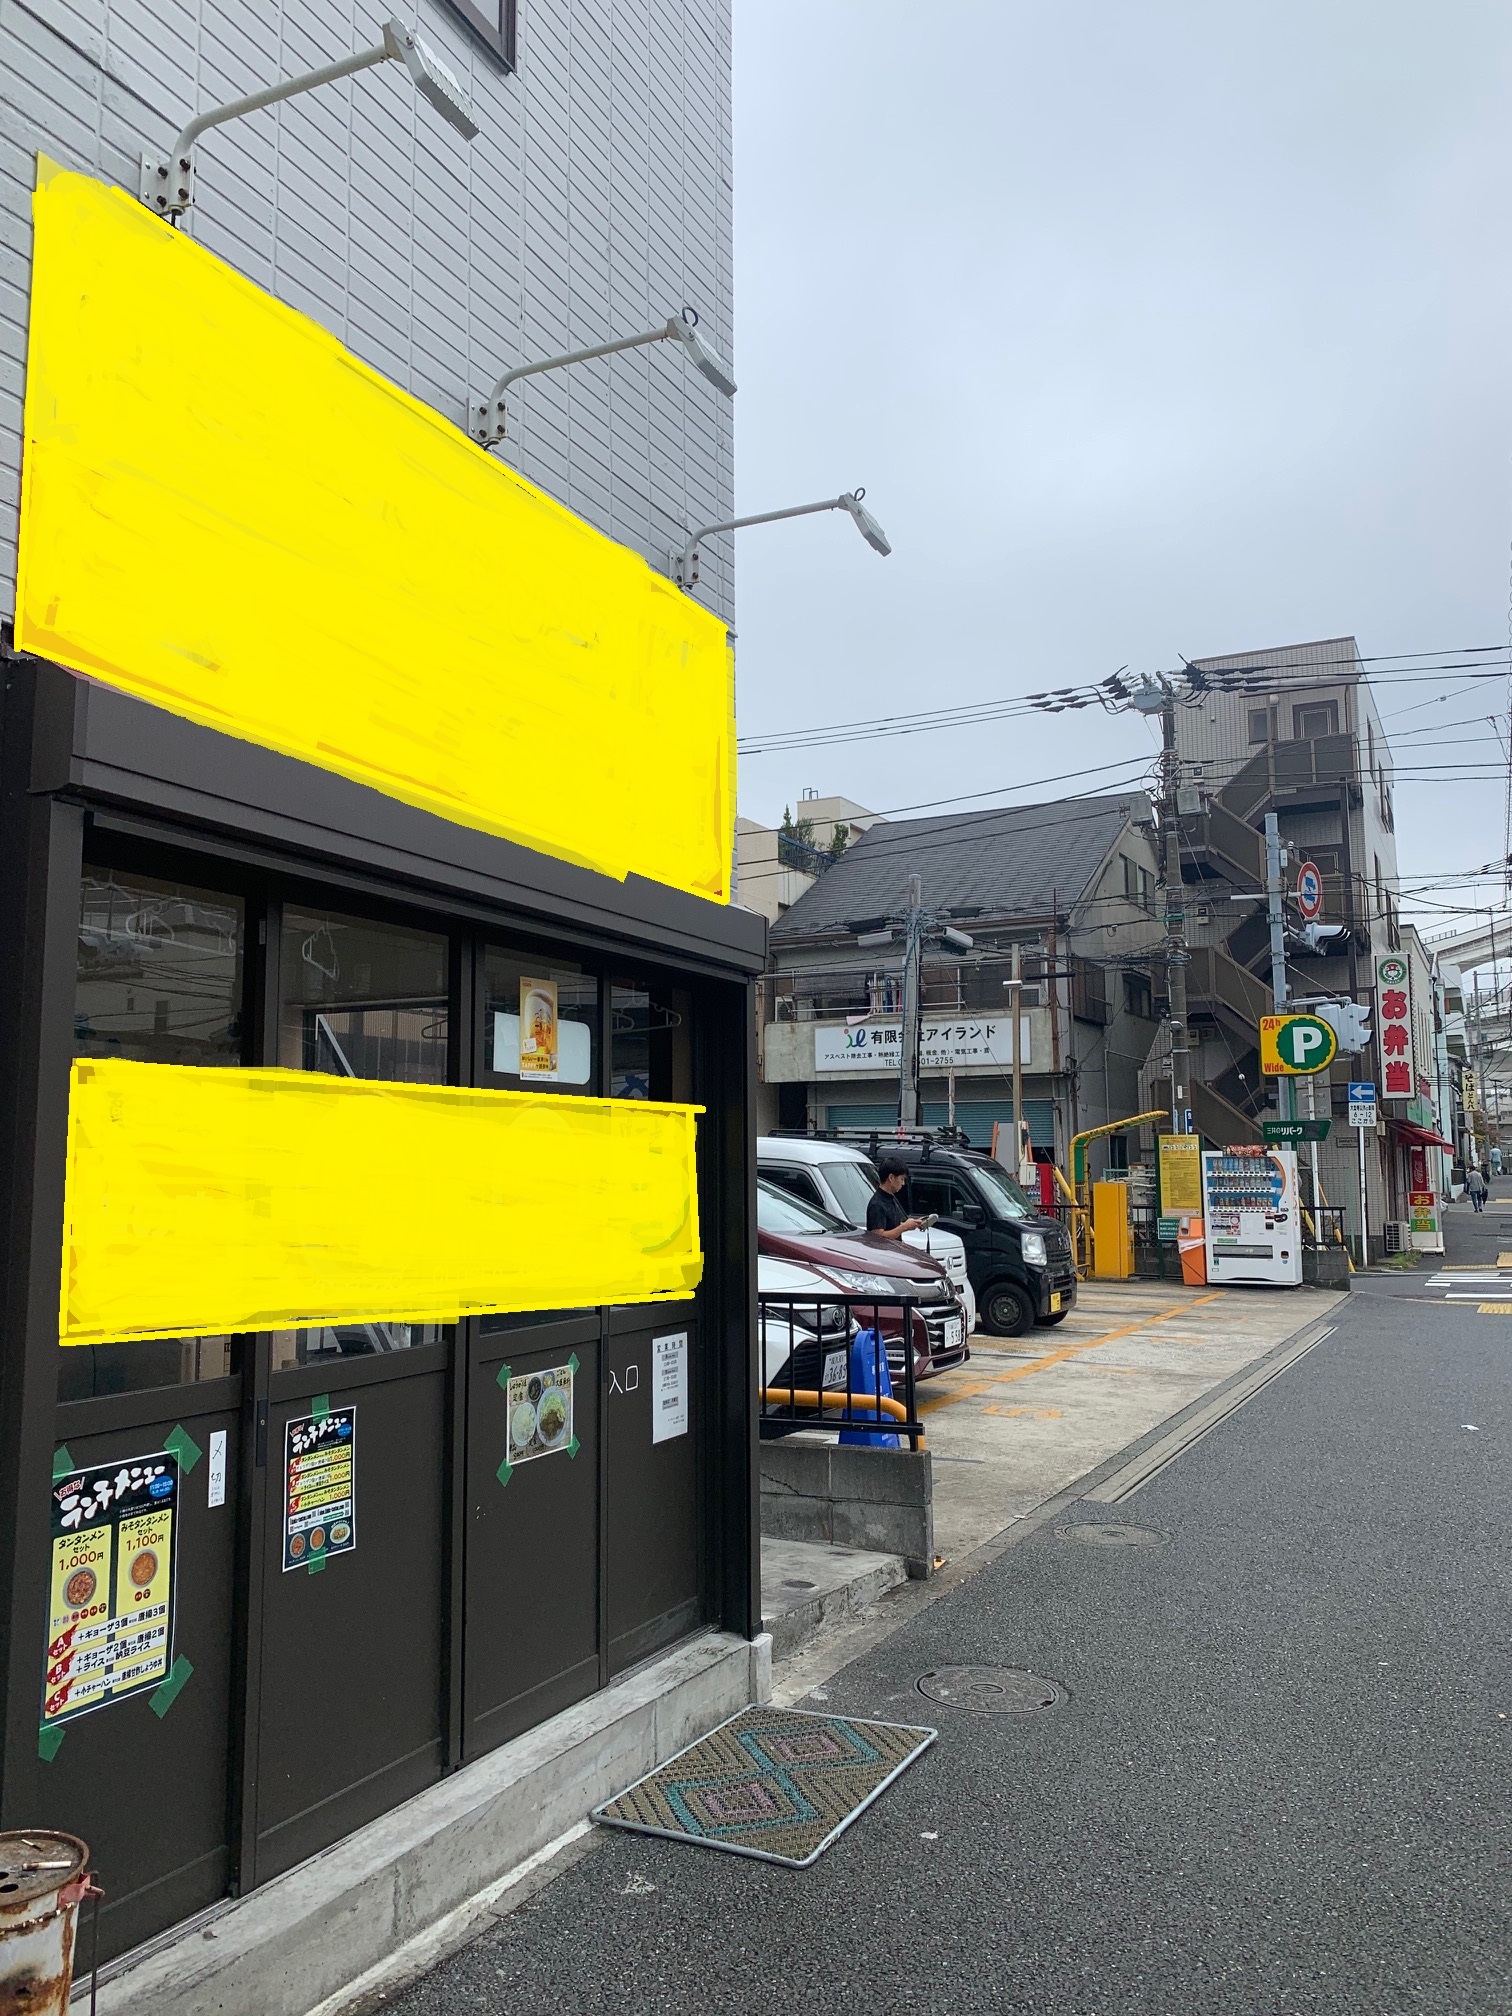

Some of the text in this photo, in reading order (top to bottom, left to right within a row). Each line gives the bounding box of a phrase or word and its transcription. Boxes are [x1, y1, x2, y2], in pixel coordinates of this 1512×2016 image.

[1263, 1018, 1281, 1031] 24h
[1292, 1026, 1323, 1063] P
[1382, 989, 1410, 1093] お弁当
[1264, 1063, 1285, 1073] Wide
[1266, 1126, 1303, 1136] 三井のリパーク
[1413, 1194, 1432, 1231] お弁当
[608, 1364, 639, 1395] 入口
[292, 1417, 347, 1455] ランチメニュー
[58, 1480, 81, 1498] お得な
[60, 1465, 165, 1529] ランチメニュー
[120, 1513, 169, 1532] みそタンタンメン
[137, 1527, 153, 1536] セット
[58, 1530, 105, 1550] タンタンメン
[73, 1543, 90, 1554] セット
[126, 1533, 165, 1551] 1,100円
[58, 1551, 104, 1571] 1,000円
[52, 1636, 67, 1656] A セット
[51, 1663, 66, 1684] B セット
[49, 1690, 65, 1712] C セット
